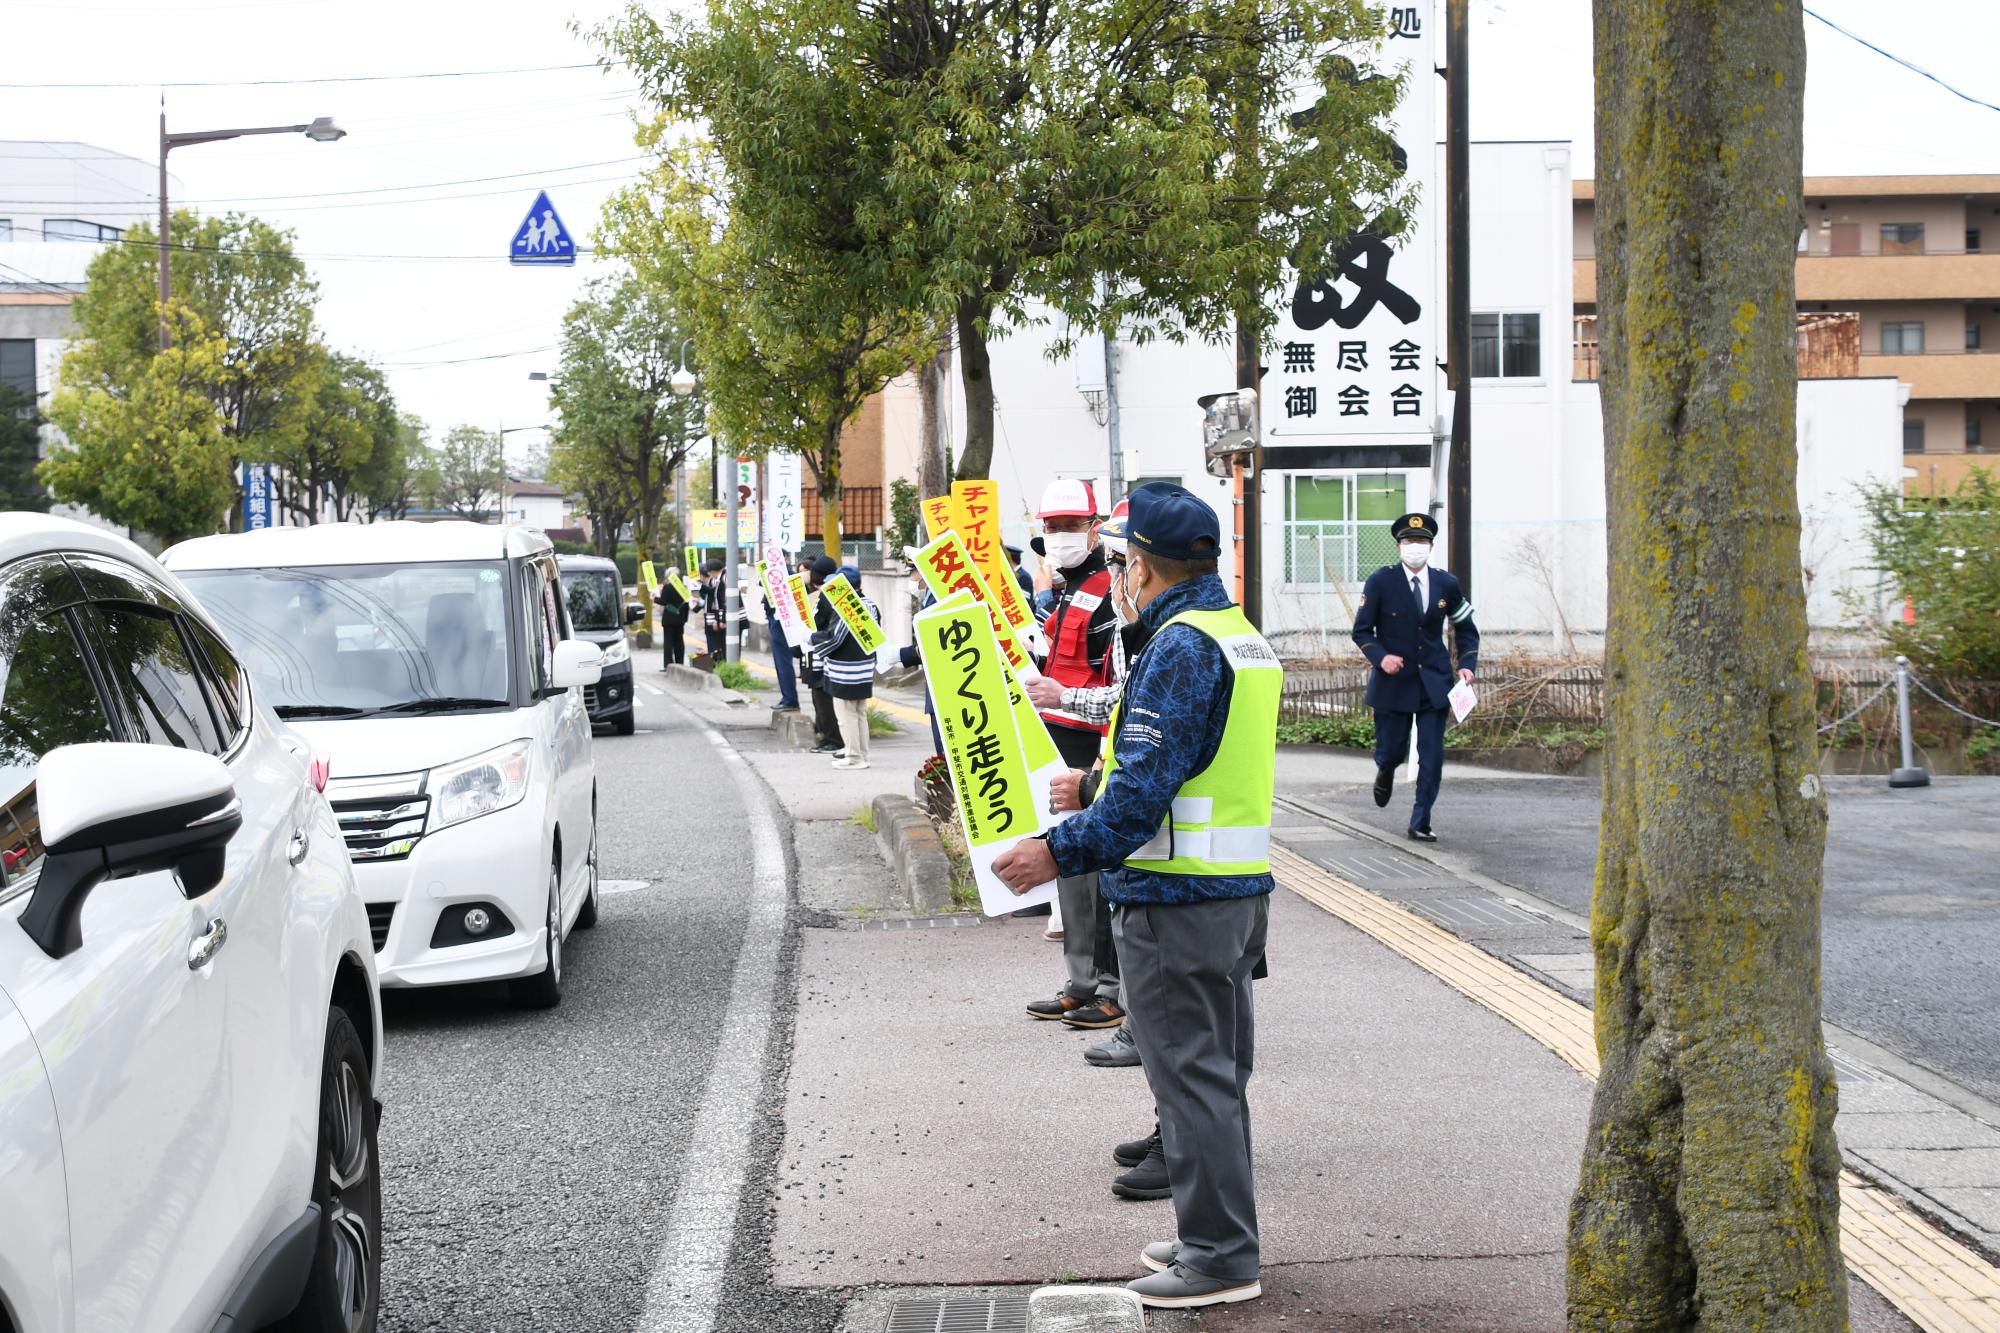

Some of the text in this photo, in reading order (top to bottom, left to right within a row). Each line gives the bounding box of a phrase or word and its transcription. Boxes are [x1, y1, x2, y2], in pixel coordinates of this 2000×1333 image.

[1284, 340, 1421, 374] 無尽会
[1285, 383, 1423, 418] 御会合
[939, 618, 1013, 833] ゆっくり走ろう
[1131, 707, 1160, 719] HEAD
